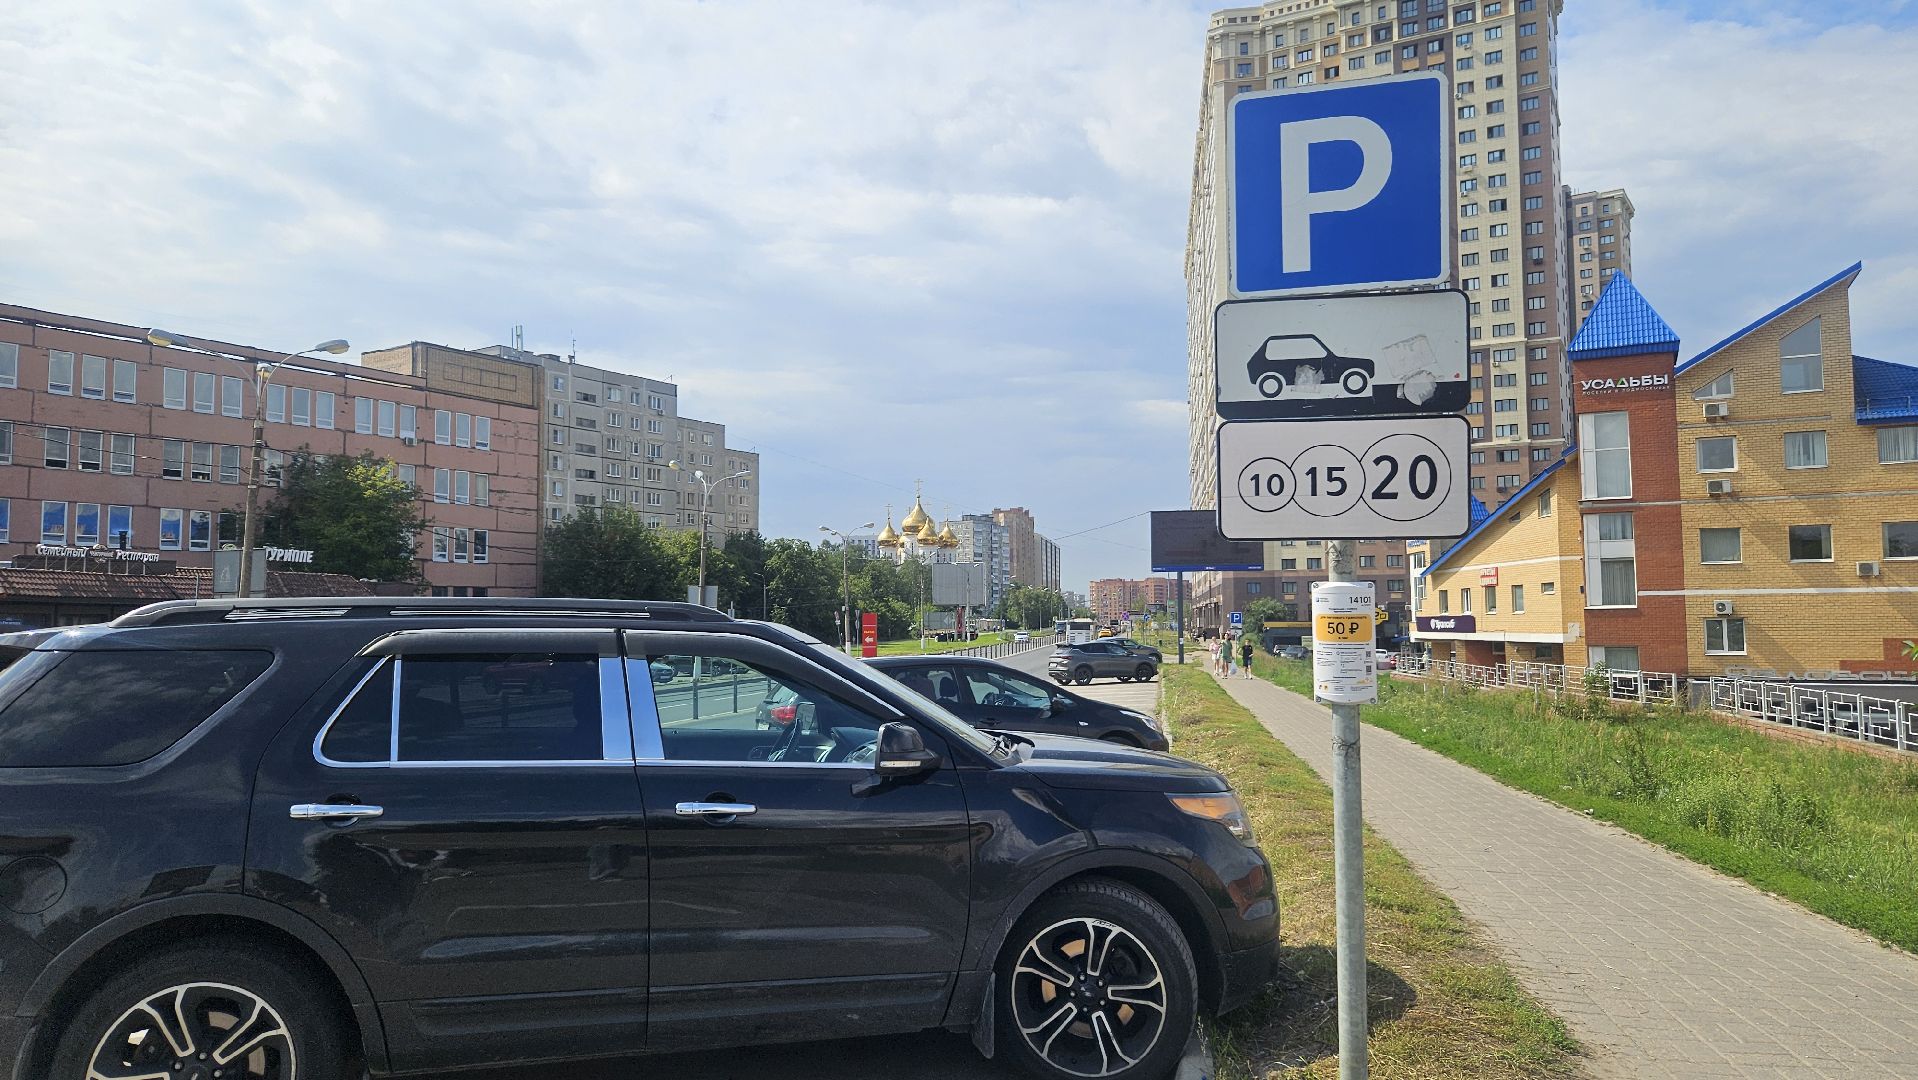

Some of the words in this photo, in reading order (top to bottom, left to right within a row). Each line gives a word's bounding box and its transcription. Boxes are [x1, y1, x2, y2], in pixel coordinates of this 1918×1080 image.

[1279, 115, 1392, 274] P
[1580, 374, 1669, 391] УСАДЬБЫ
[1249, 473, 1285, 497] 10
[1304, 466, 1348, 497] 15
[1371, 454, 1438, 500] 20
[1327, 622, 1345, 634] 50
[1349, 622, 1359, 634] ₽
